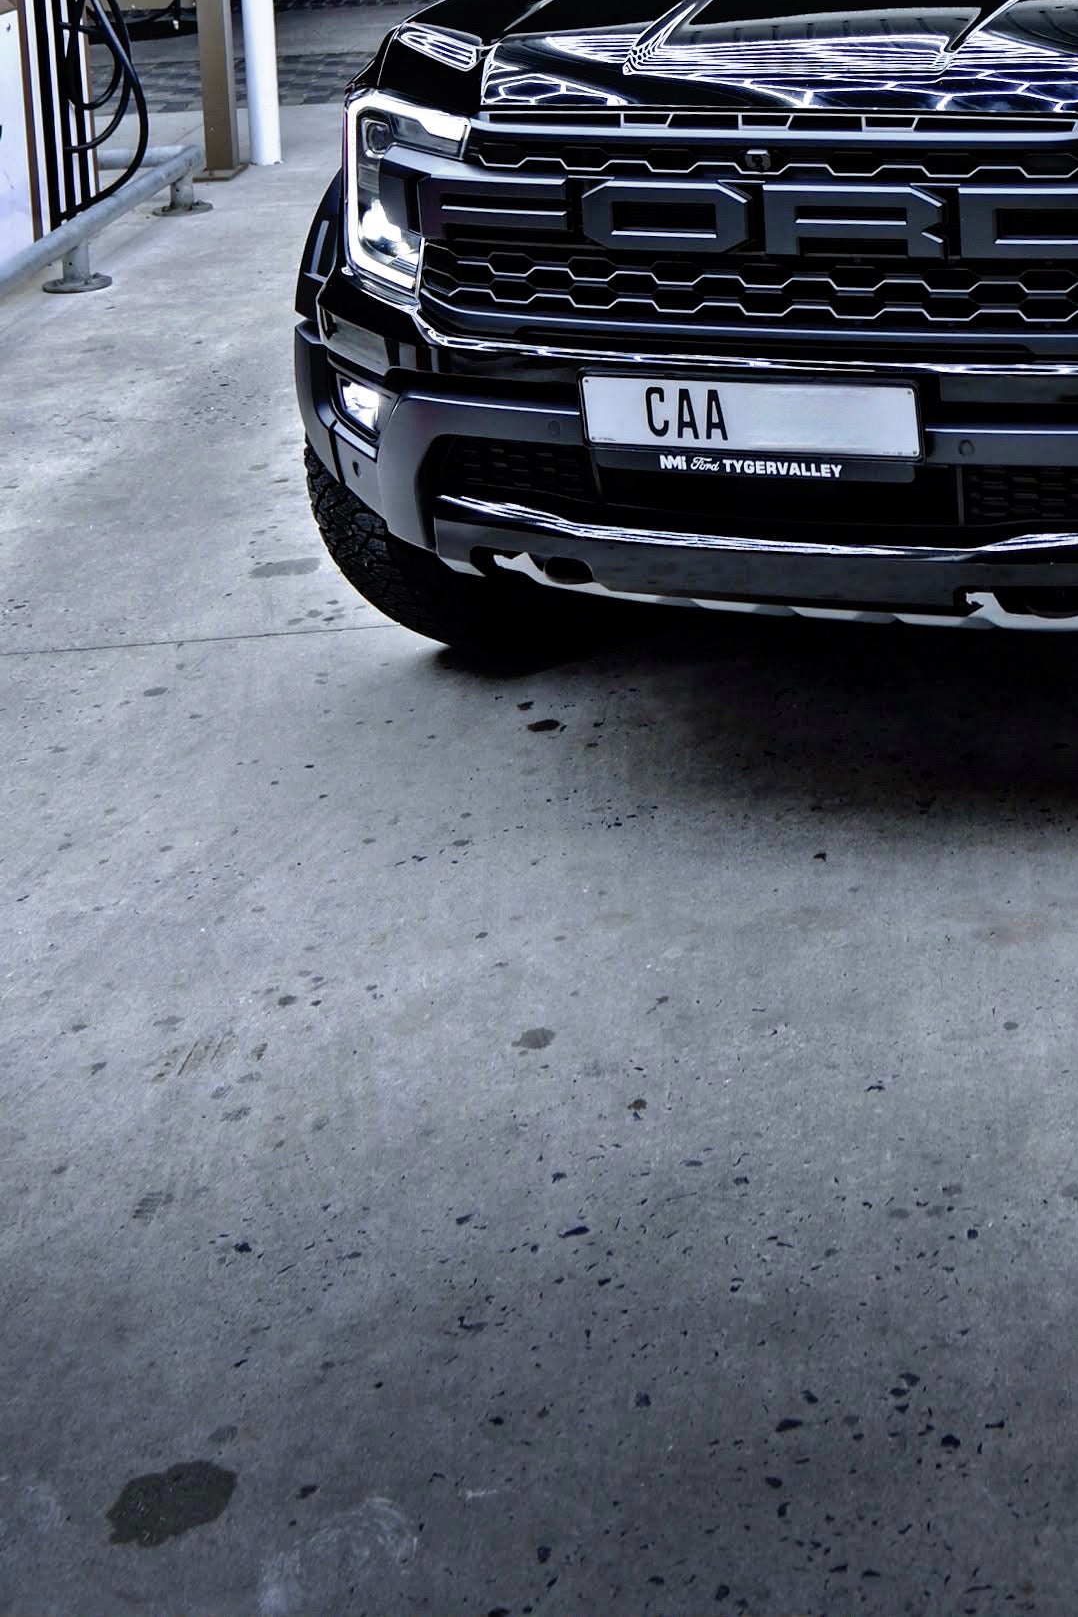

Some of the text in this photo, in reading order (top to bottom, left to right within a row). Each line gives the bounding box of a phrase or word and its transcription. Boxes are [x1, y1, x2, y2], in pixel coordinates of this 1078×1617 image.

[644, 385, 729, 442] CAA
[690, 456, 720, 472] Ford
[722, 459, 842, 479] TYGERVALLEY
